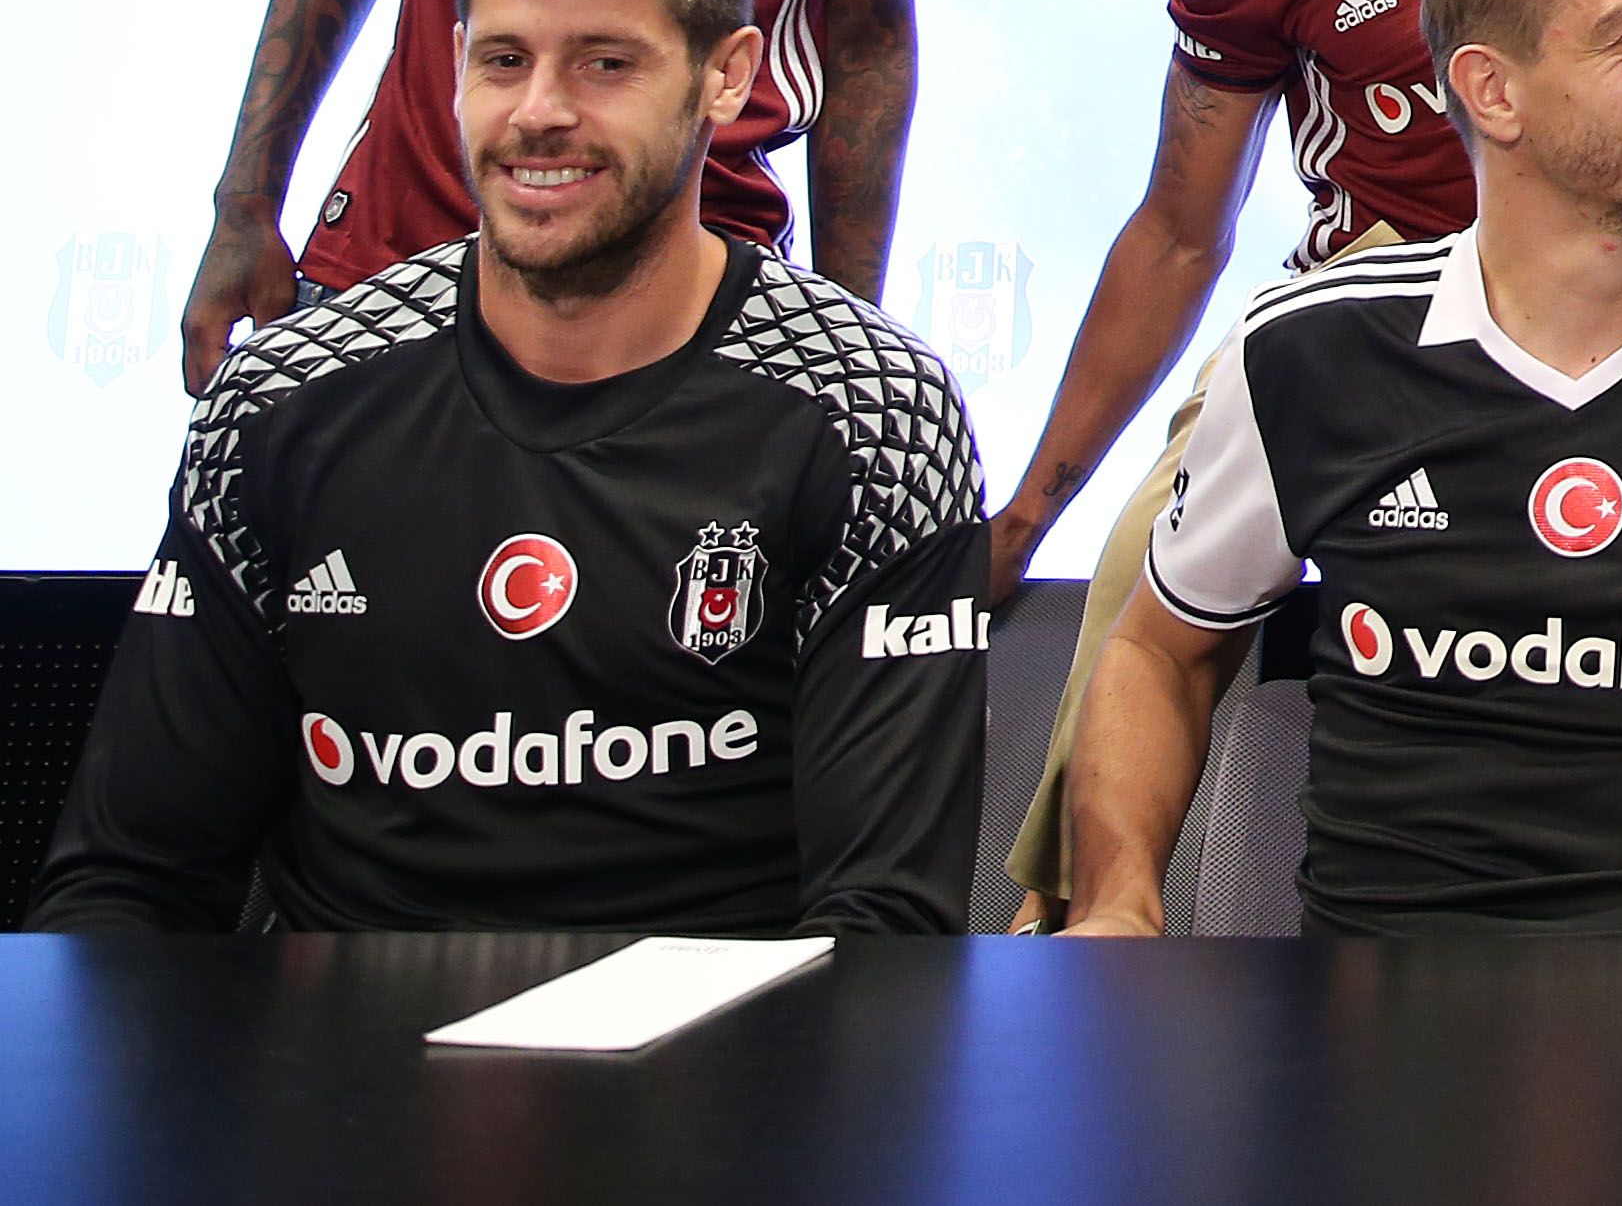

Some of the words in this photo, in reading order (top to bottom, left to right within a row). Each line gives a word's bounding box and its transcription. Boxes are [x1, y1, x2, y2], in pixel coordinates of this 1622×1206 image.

[1368, 505, 1449, 531] adidas
[690, 557, 754, 583] BJK
[287, 590, 368, 614] adidas
[690, 628, 743, 649] 1903
[360, 708, 759, 790] vodafone
